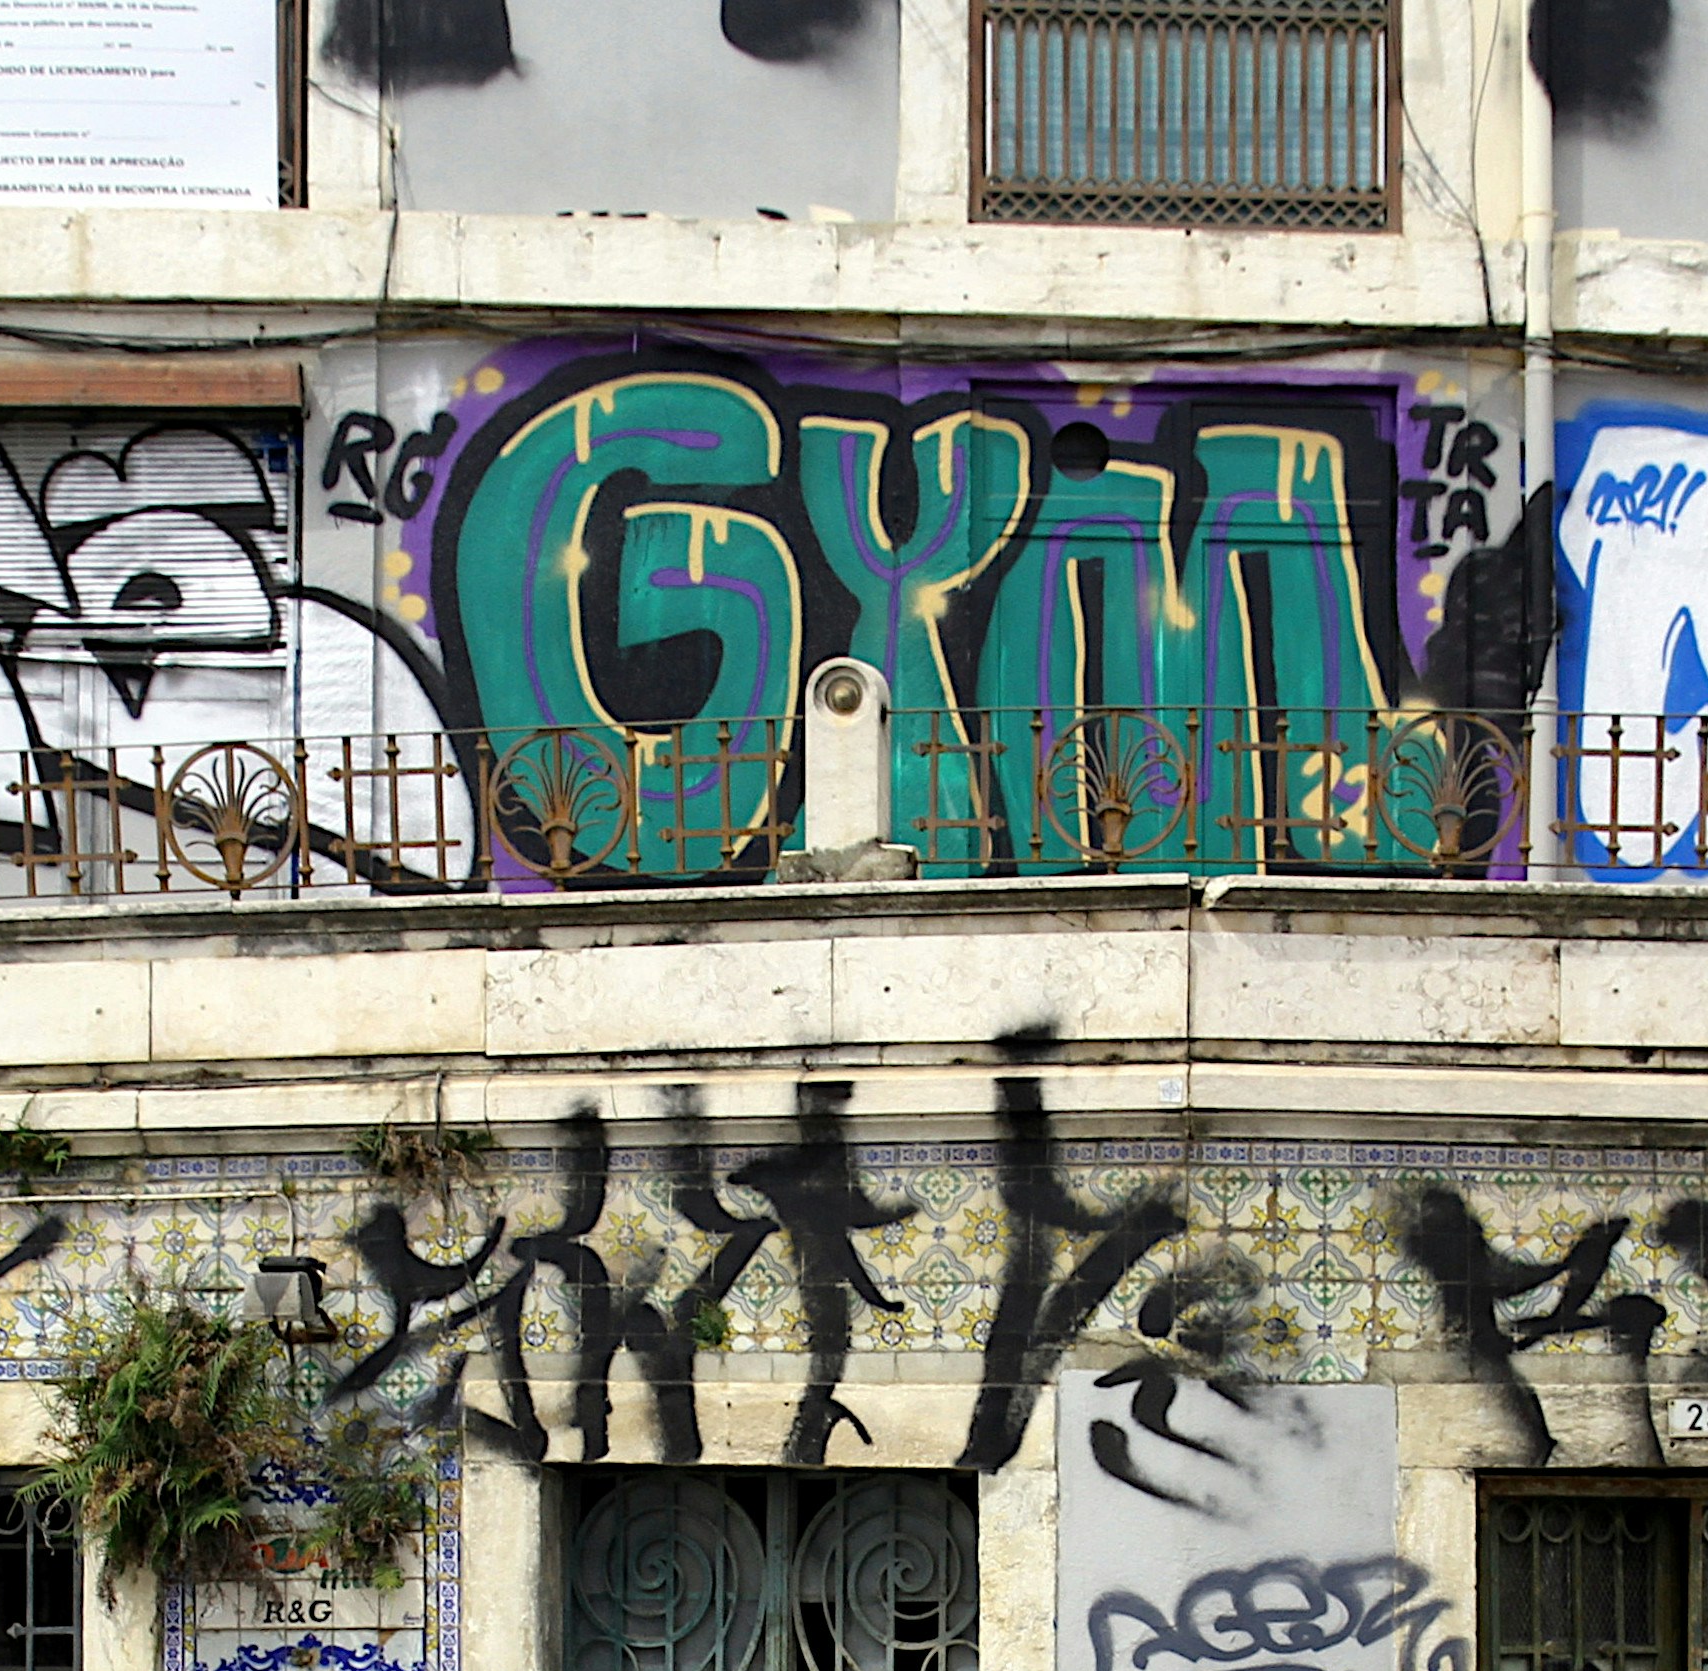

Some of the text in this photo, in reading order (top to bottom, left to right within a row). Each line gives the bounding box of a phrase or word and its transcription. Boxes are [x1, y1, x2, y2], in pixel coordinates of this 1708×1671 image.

[29, 65, 45, 75] DE
[48, 65, 147, 76] LICENCIAMENTO
[150, 68, 176, 78] para
[37, 155, 55, 165] EM
[58, 155, 87, 165] FASE
[89, 156, 105, 166] DE
[109, 154, 185, 169] APRECIAÇÃO
[115, 184, 178, 195] ENCONTRA
[181, 186, 252, 197] LICENCIADA
[263, 1599, 333, 1624] R&G
